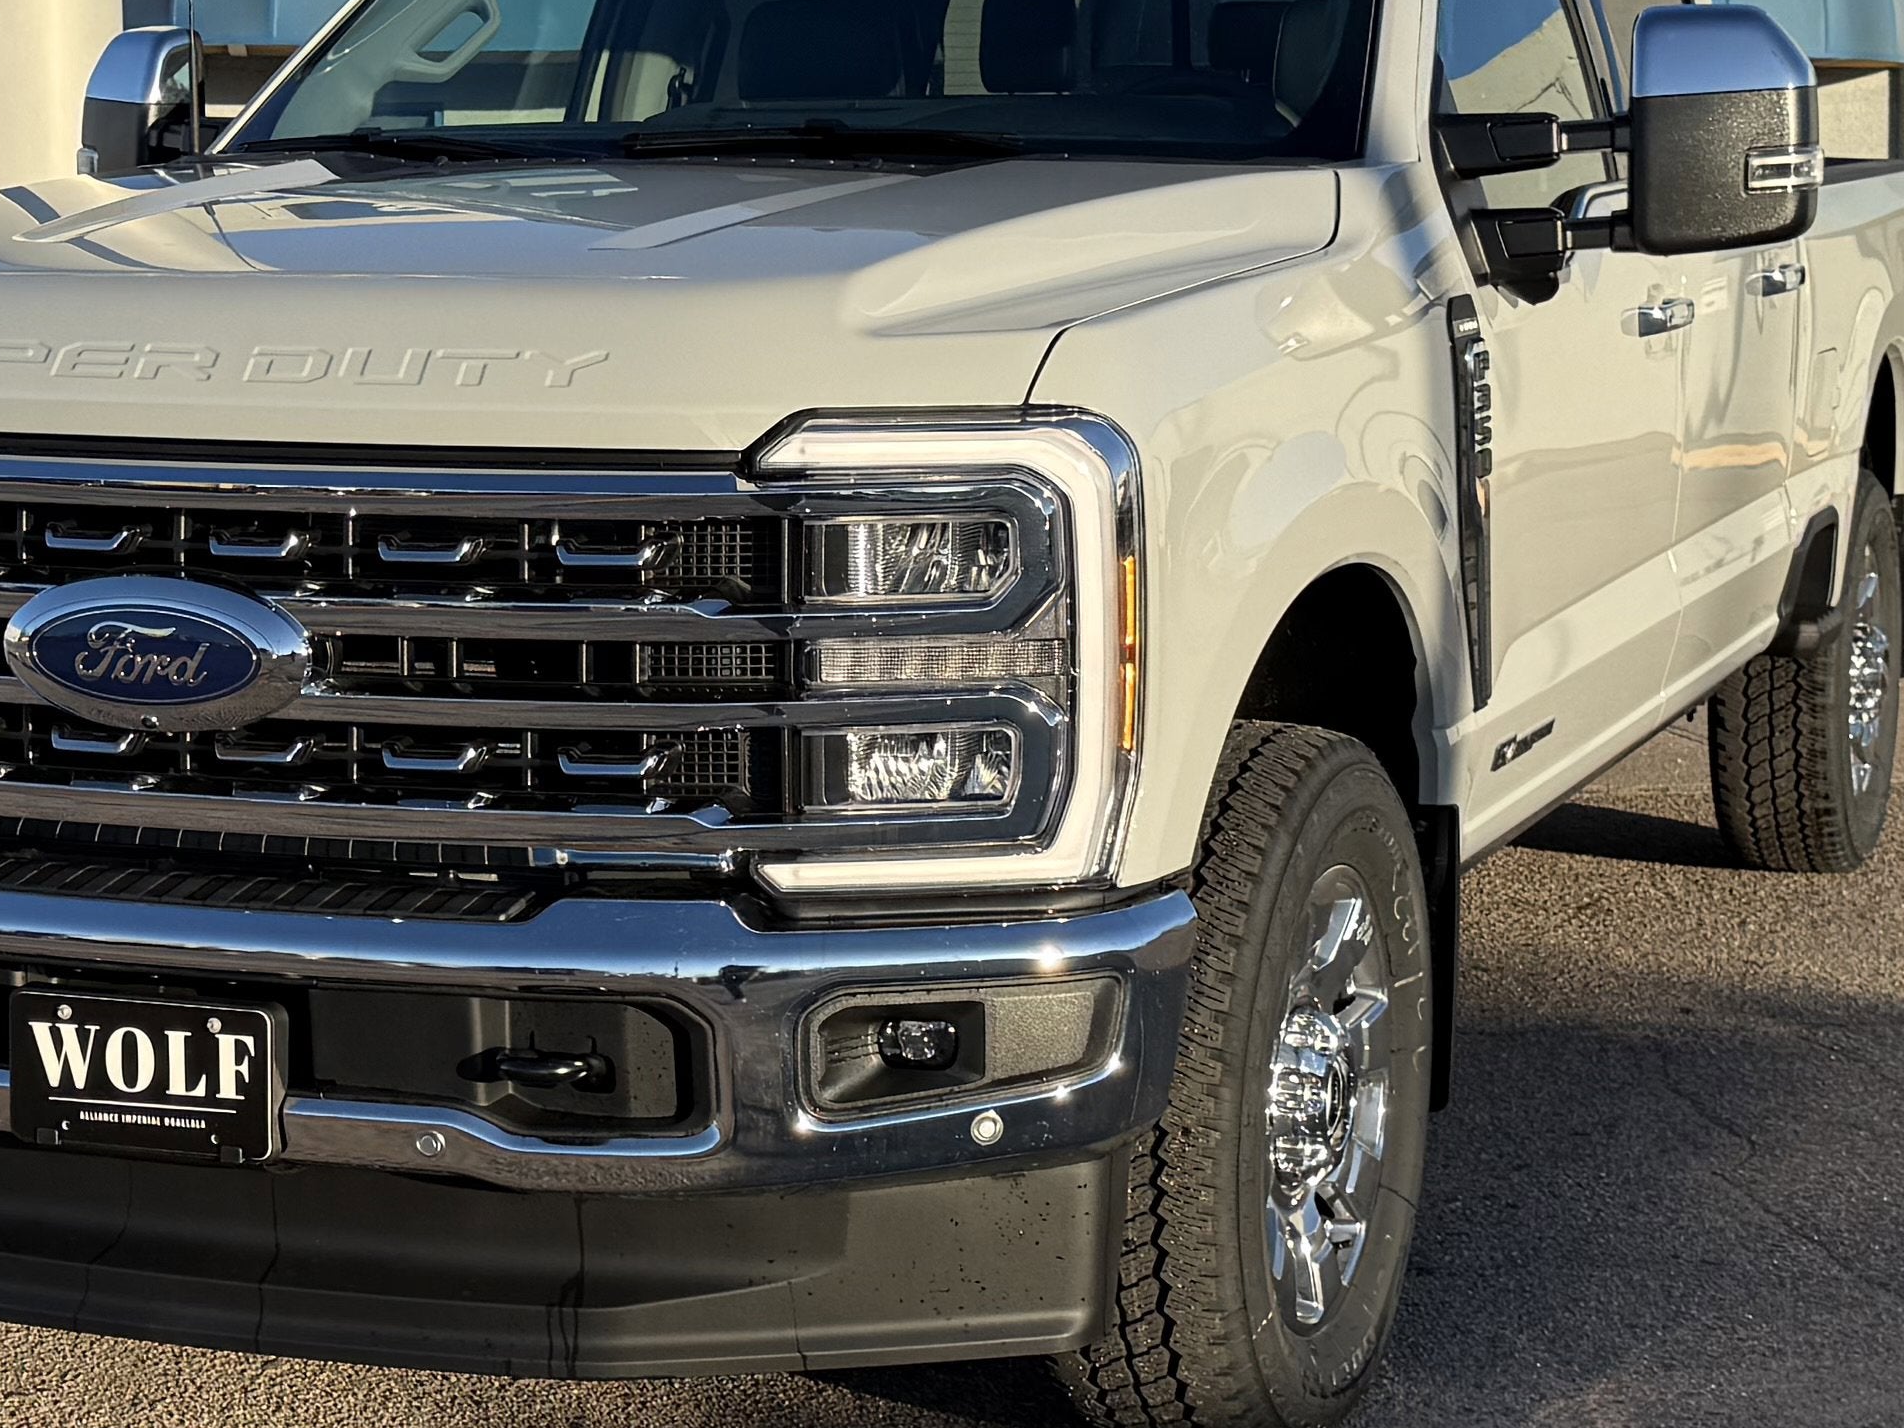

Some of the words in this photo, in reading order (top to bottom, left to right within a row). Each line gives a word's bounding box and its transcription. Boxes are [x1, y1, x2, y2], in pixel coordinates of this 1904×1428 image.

[243, 347, 610, 388] DUTY
[75, 621, 208, 687] Ford
[28, 1021, 255, 1100] WOLF
[80, 1110, 119, 1123] ALLIANCE
[121, 1114, 161, 1126] IMPERIAL
